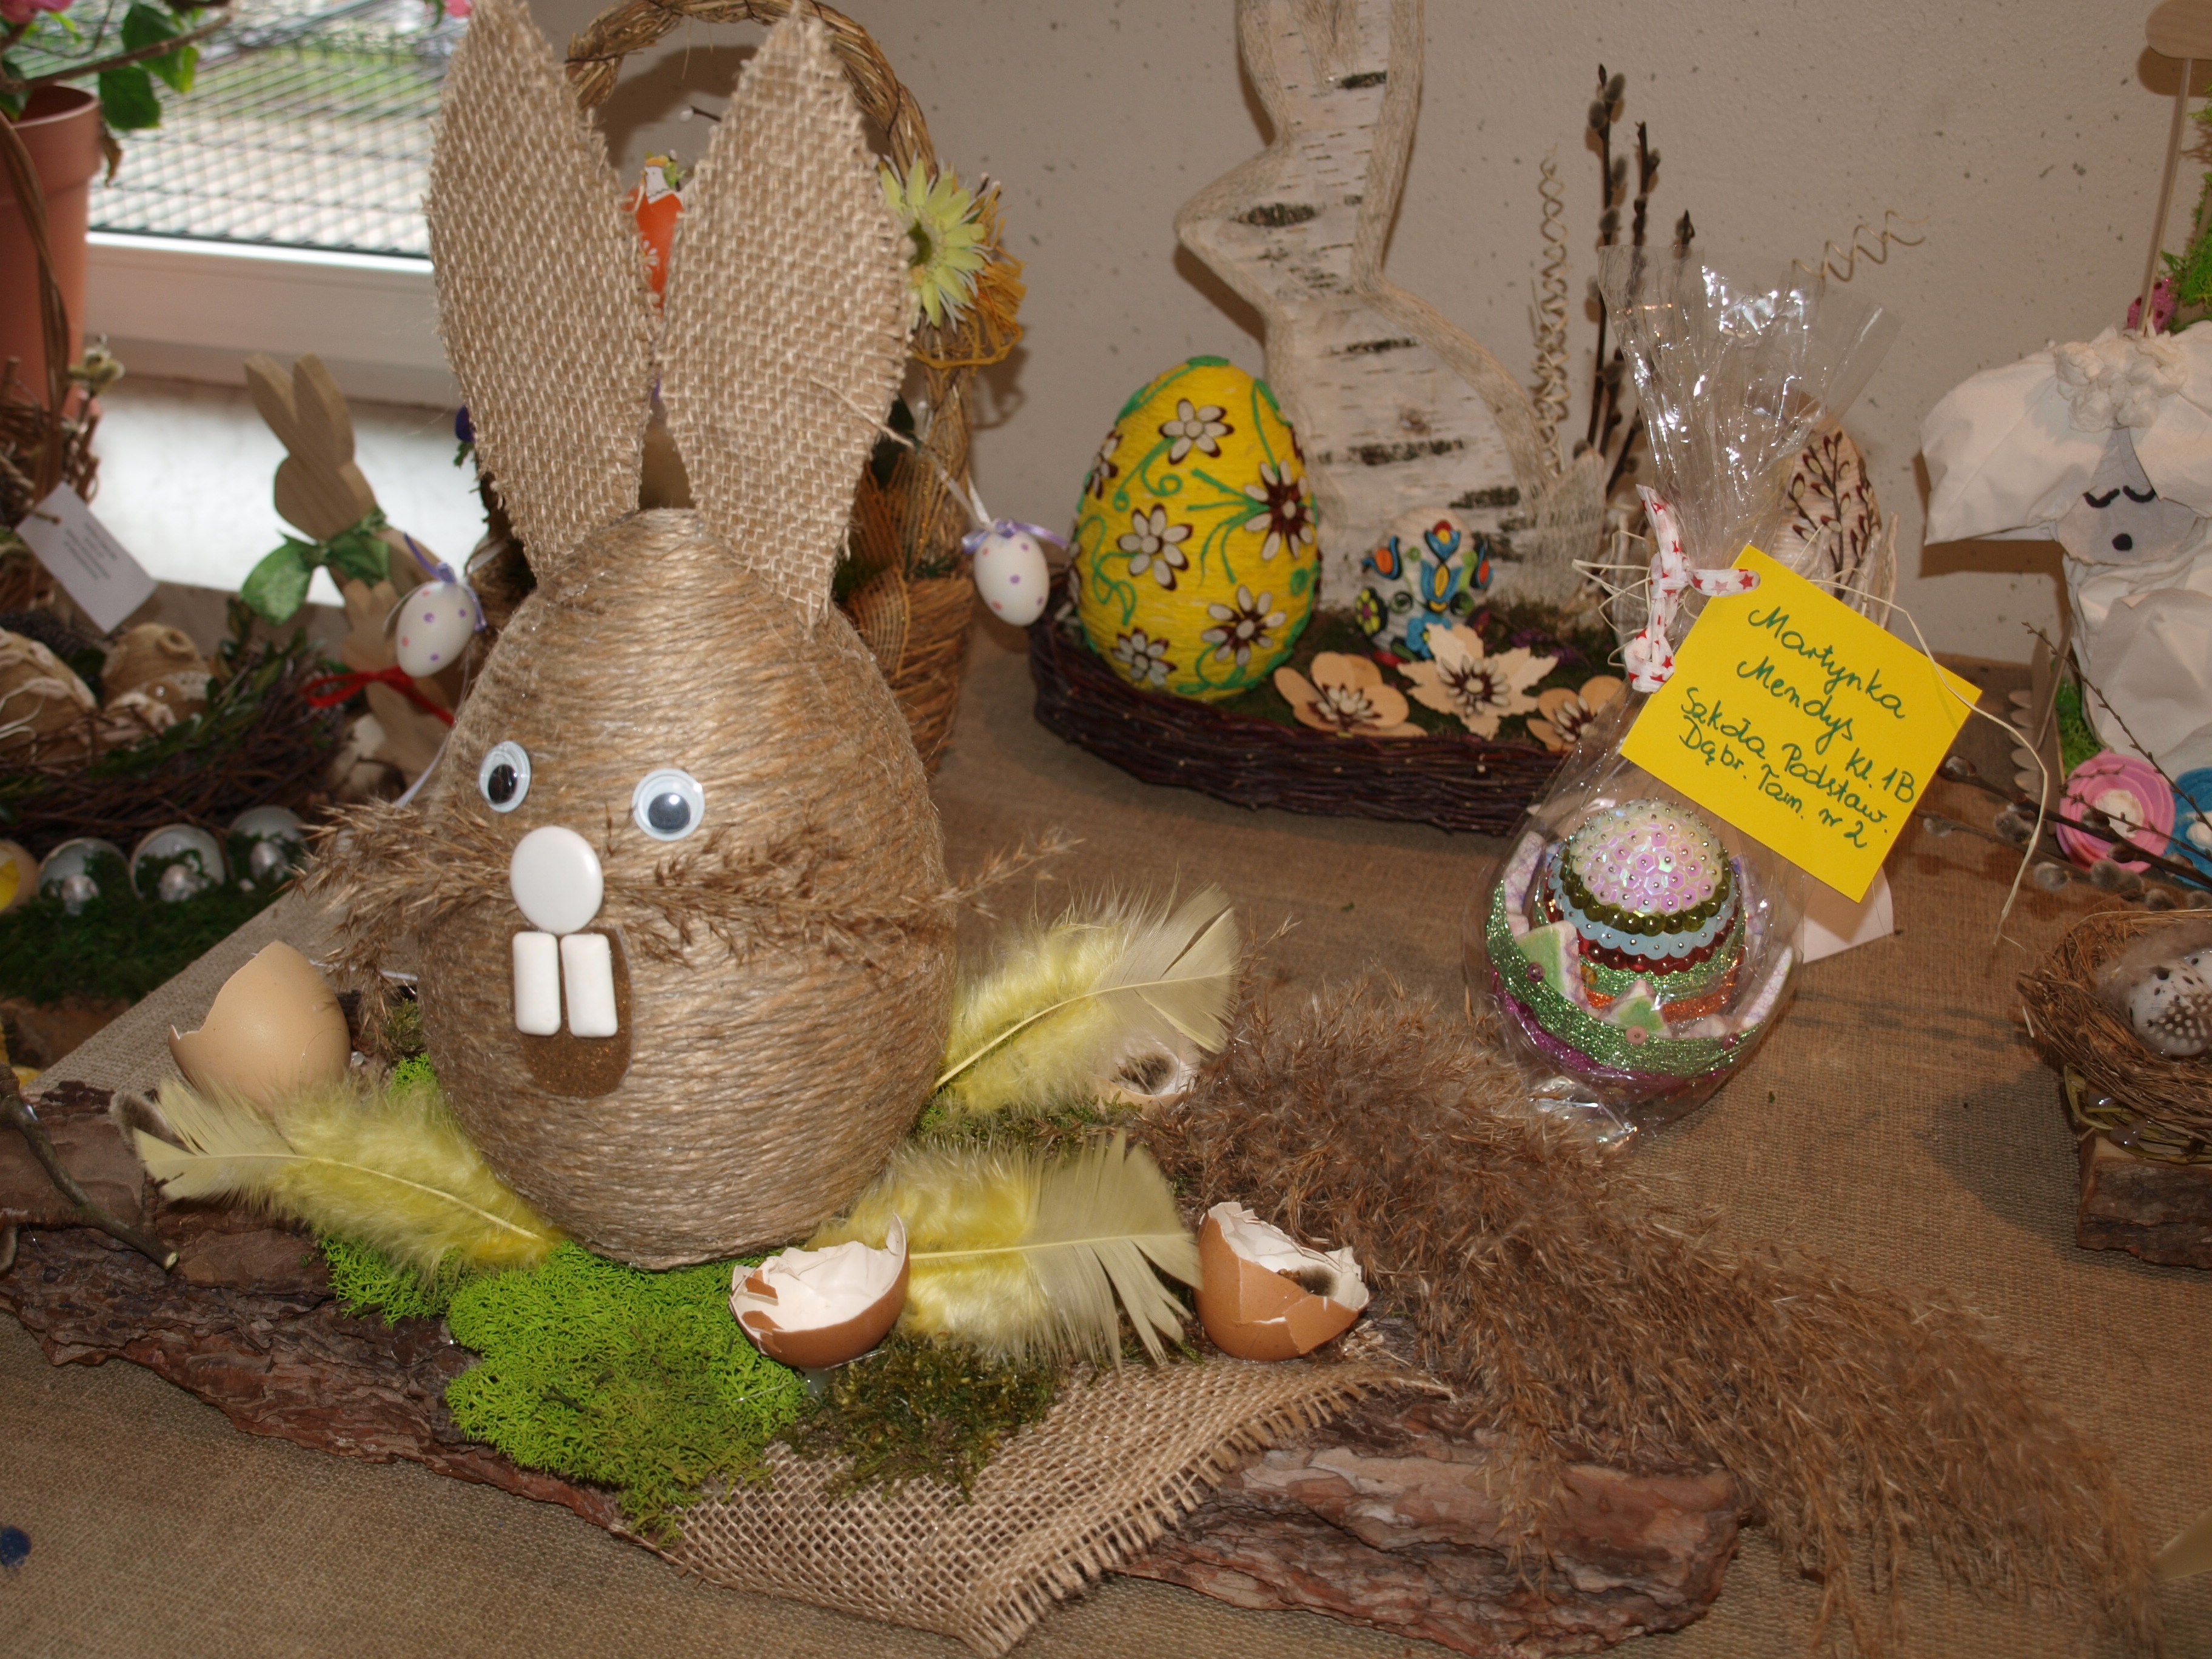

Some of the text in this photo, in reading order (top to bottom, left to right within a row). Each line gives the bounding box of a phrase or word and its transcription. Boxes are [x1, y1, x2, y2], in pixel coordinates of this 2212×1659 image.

[1748, 606, 1906, 720] Martynka
[1737, 656, 1853, 756] Mendys
[1882, 766, 1915, 803] 1B
[1843, 820, 1868, 848] 2
